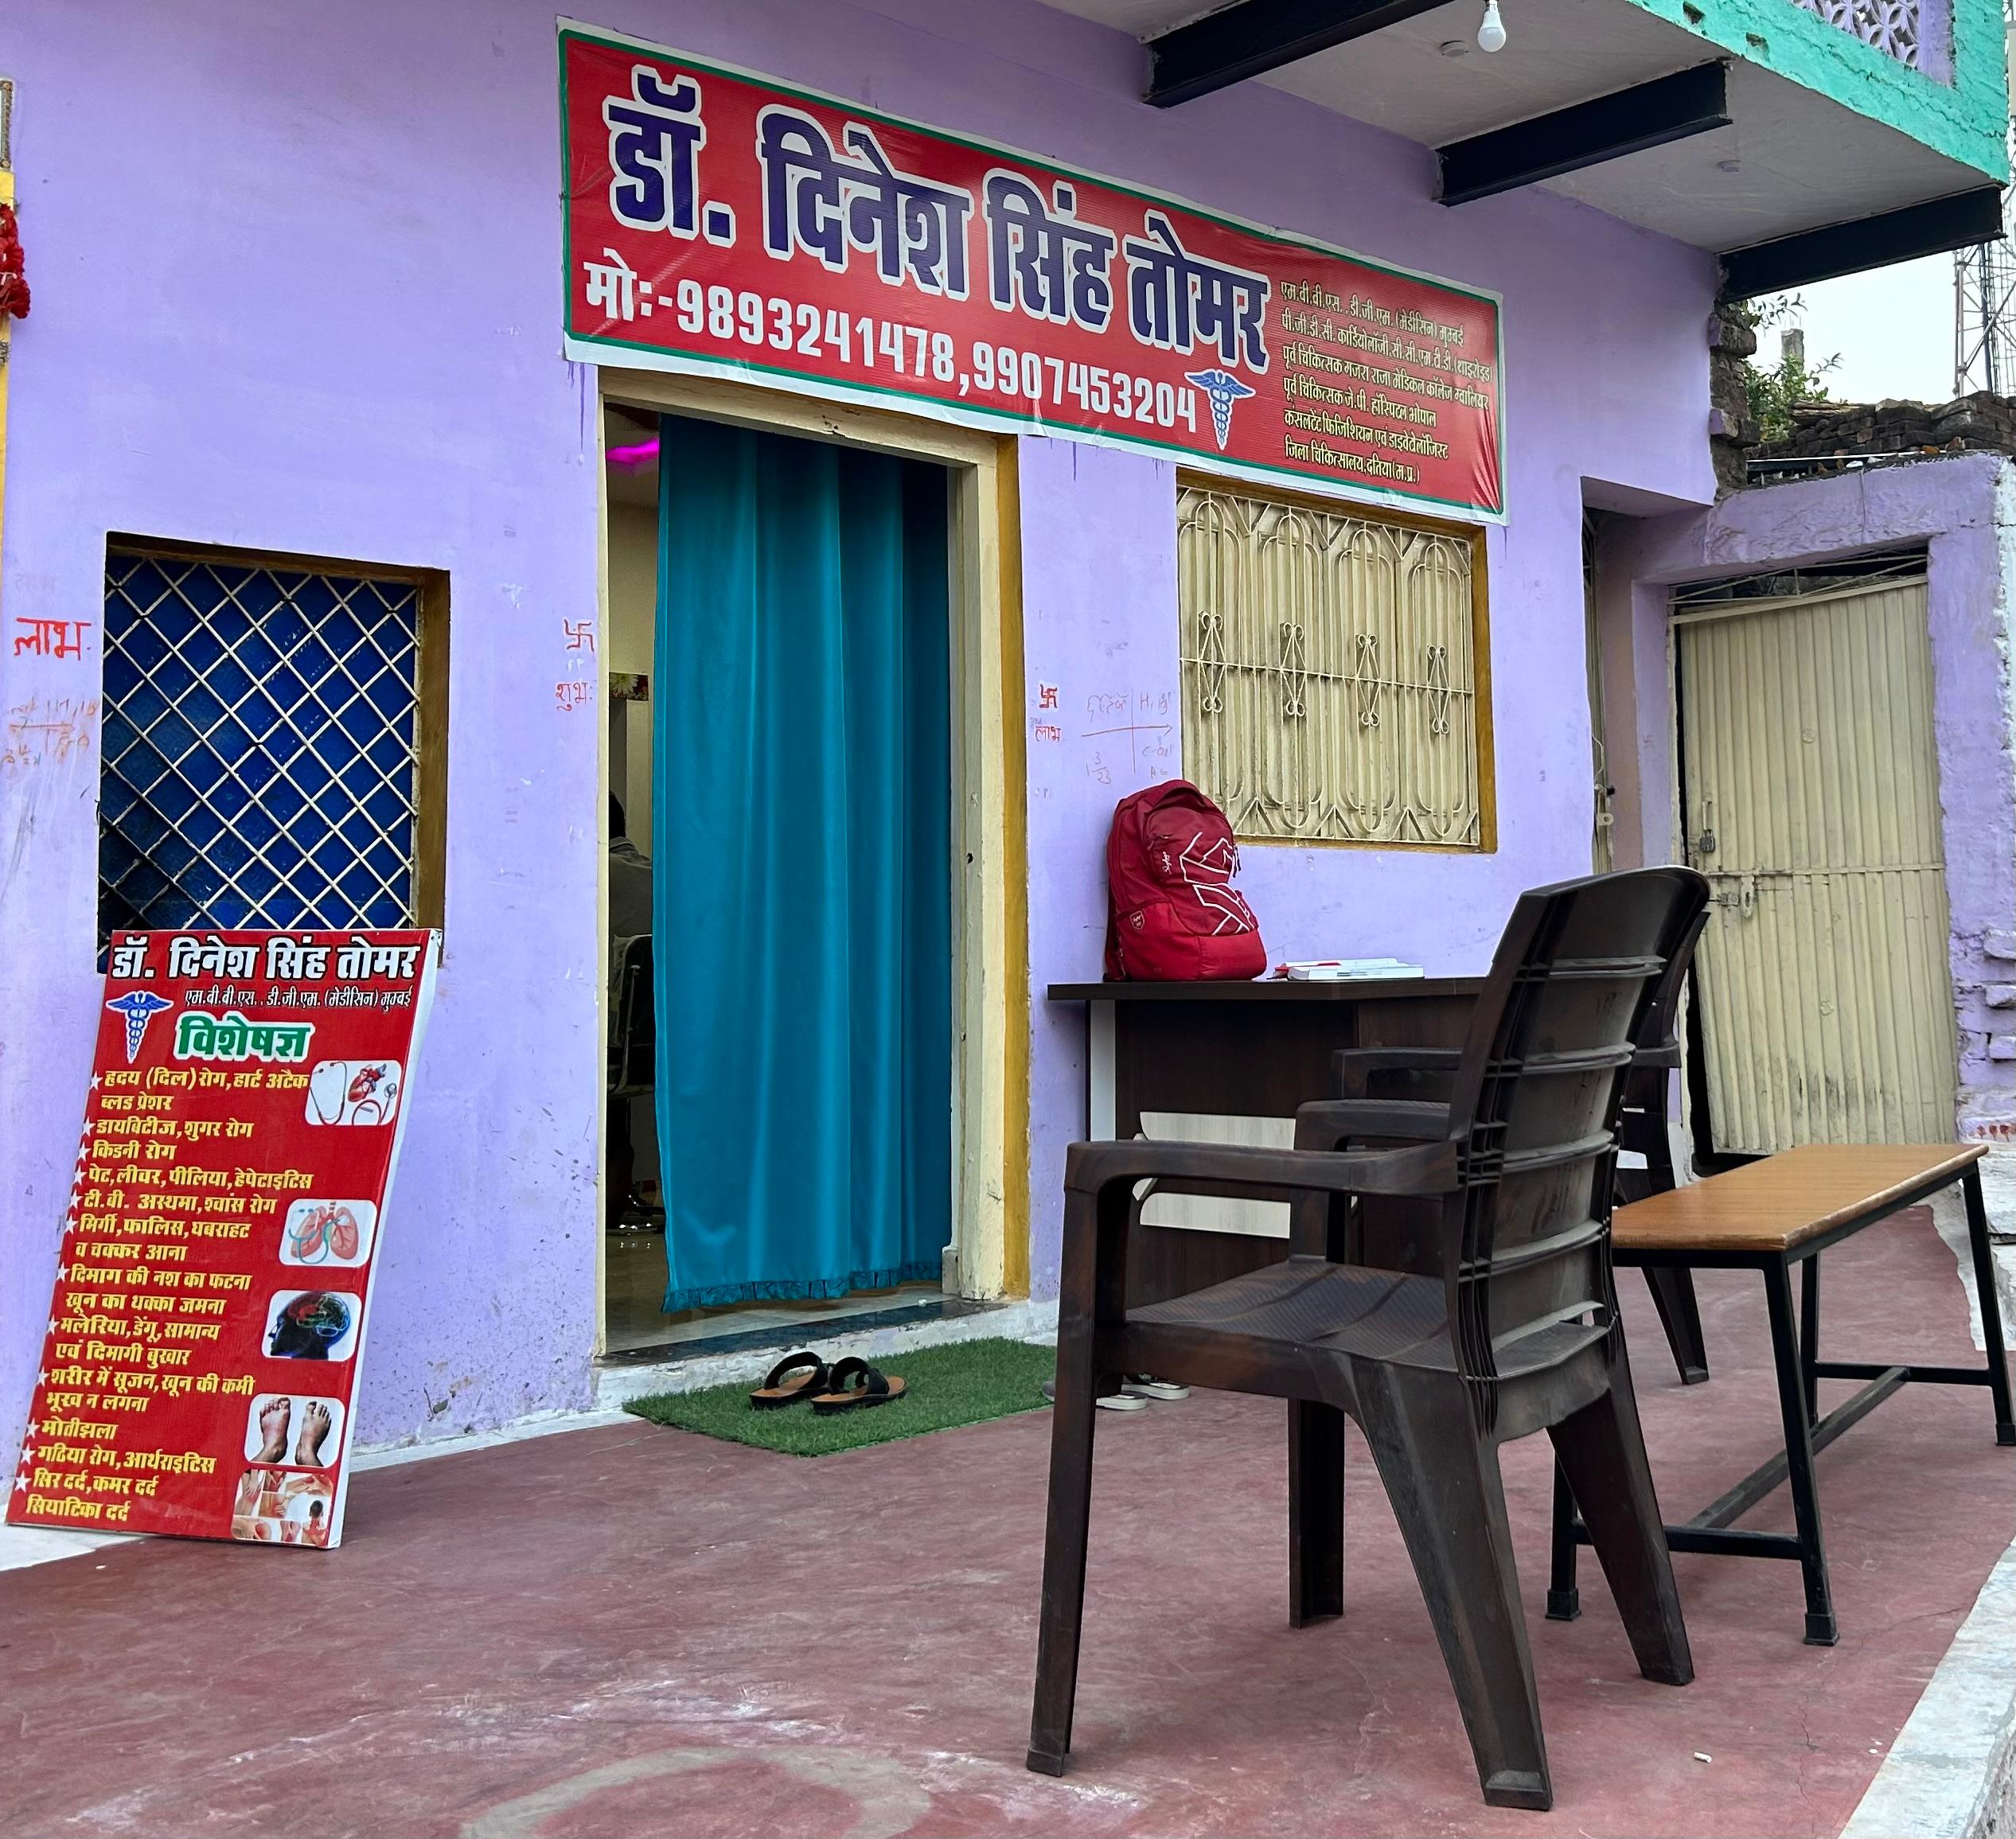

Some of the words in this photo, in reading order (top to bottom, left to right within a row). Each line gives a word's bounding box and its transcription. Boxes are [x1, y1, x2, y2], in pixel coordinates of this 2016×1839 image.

[603, 65, 735, 247] डॉ.
[756, 104, 973, 302] दिनेश
[983, 168, 1116, 333] सिंह
[1121, 208, 1271, 374] तोमर
[1283, 341, 1297, 370] पूर्व
[1298, 342, 1343, 374] चिकित्सक
[1343, 360, 1369, 381] गजरा
[1371, 368, 1391, 387] राजा
[1426, 376, 1453, 400] कॉलेज
[1454, 385, 1488, 410] ग्वालियर
[1284, 373, 1297, 402] पूर्व
[1299, 373, 1343, 405] चिकित्सक
[1408, 402, 1436, 427] भोपाल
[1285, 434, 1309, 461] जिला
[1375, 426, 1386, 447] एवं
[111, 935, 154, 978] डॉ.
[169, 934, 260, 978] दिनेश
[266, 935, 331, 979] सिंह
[337, 935, 421, 979] तोमर
[174, 1010, 316, 1062] विशेषज्ञ
[103, 1070, 142, 1089] हृदय
[266, 1069, 310, 1089] अटैक
[101, 1095, 135, 1110] ब्लड
[137, 1091, 174, 1111] प्रेशर
[225, 1118, 255, 1137] रोग
[92, 1139, 141, 1159] किडनी
[145, 1140, 177, 1160] रोग
[249, 1194, 278, 1214] रोग
[91, 1242, 142, 1260] चक्कर
[146, 1244, 189, 1261] आना
[70, 1264, 123, 1284] दिमाग
[126, 1266, 150, 1285] की
[154, 1271, 182, 1287] नश
[183, 1272, 207, 1288] का
[209, 1274, 252, 1290] फटना
[65, 1292, 99, 1314] खून
[101, 1294, 127, 1310] का
[131, 1295, 176, 1312] थक्का
[179, 1297, 227, 1315] जमना
[56, 1339, 84, 1359] एवं
[86, 1340, 143, 1362] दिमागी
[146, 1348, 193, 1370] बुखार
[50, 1365, 94, 1385] शरीर
[96, 1366, 113, 1385] में
[197, 1373, 220, 1393] की
[221, 1375, 255, 1395] कमी
[46, 1391, 83, 1412] भूख
[86, 1393, 99, 1408] न
[102, 1395, 150, 1412] लगना
[38, 1442, 87, 1463] गठिया
[33, 1467, 63, 1488] सिर
[135, 1475, 159, 1496] दर्द
[25, 1494, 103, 1519] सियाटिका
[106, 1500, 131, 1521] दर्द
